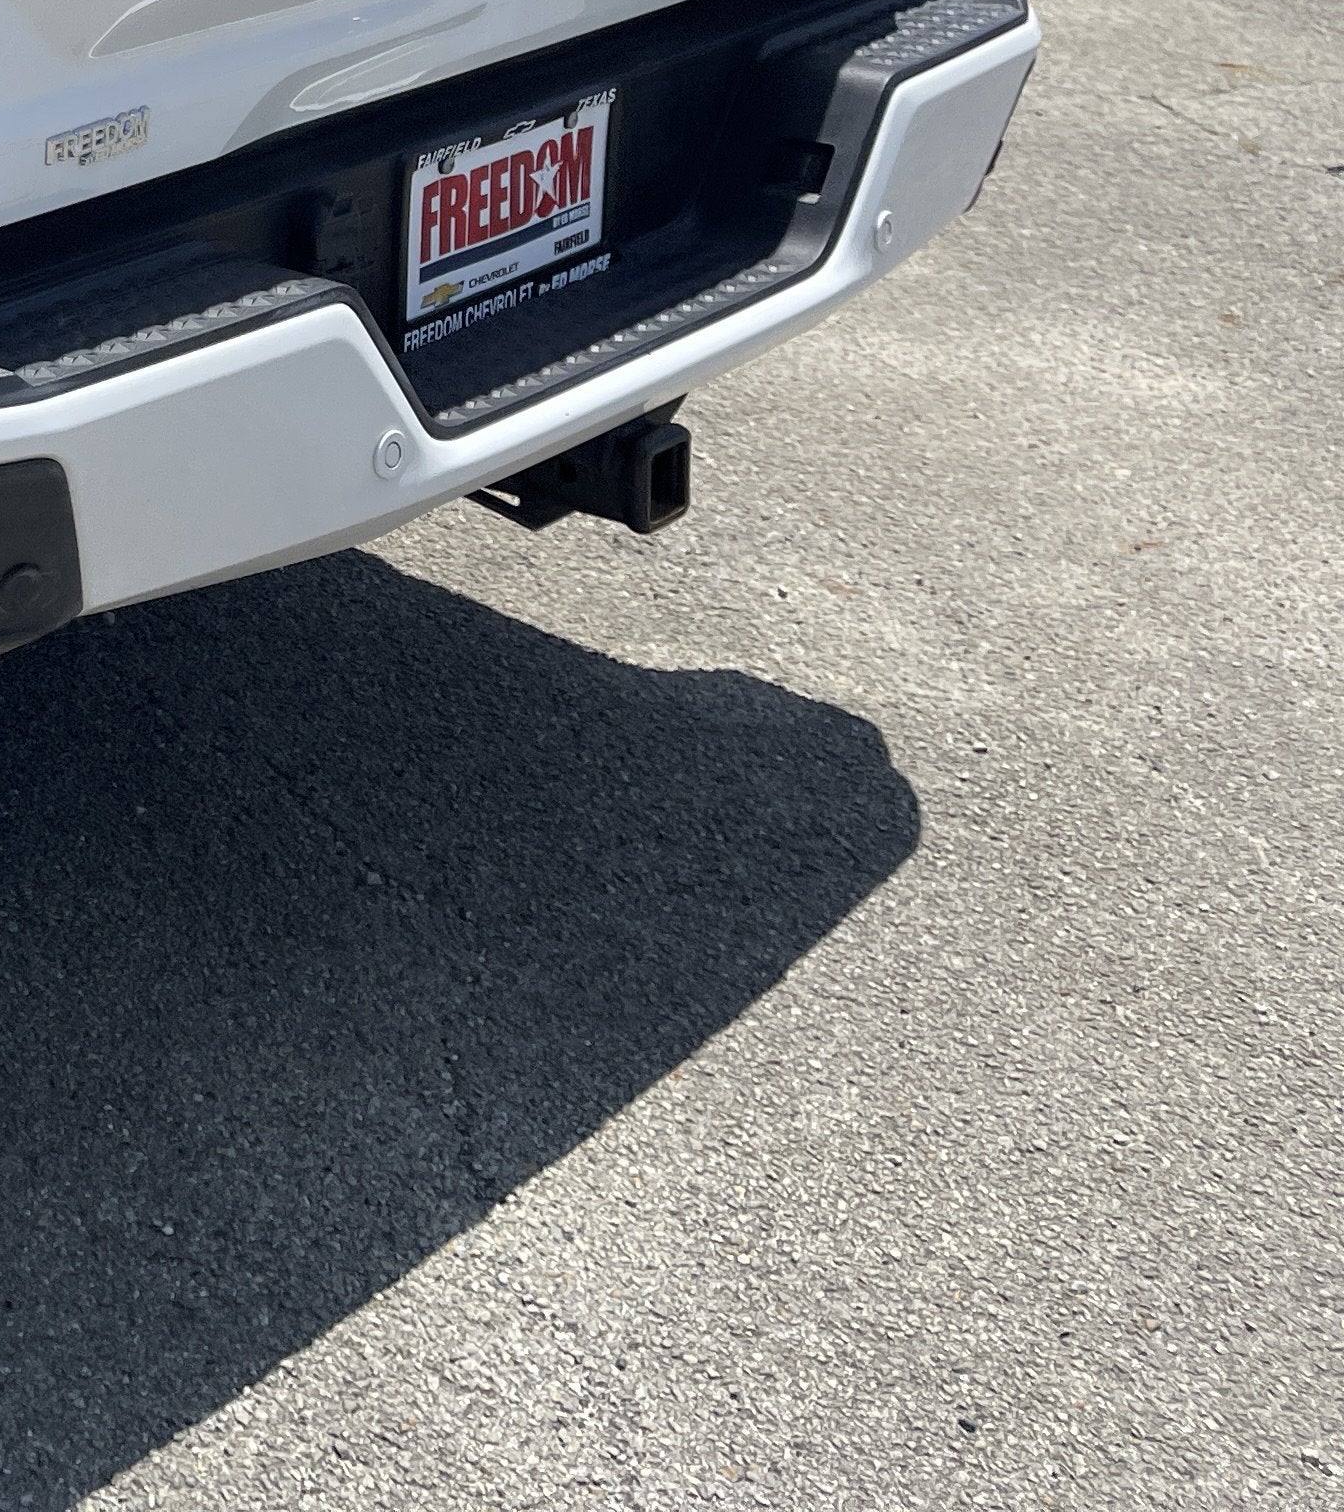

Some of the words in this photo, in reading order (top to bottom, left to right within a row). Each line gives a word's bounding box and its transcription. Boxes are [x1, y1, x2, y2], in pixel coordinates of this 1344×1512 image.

[45, 105, 150, 166] FREEDOM
[417, 137, 482, 170] FAIRFIELD
[576, 88, 618, 113] TEXAS
[419, 125, 594, 264] FREEDOM
[468, 262, 520, 289] CHEVROLET
[403, 310, 463, 354] FREEDOM
[465, 281, 535, 329] CHEVROLET
